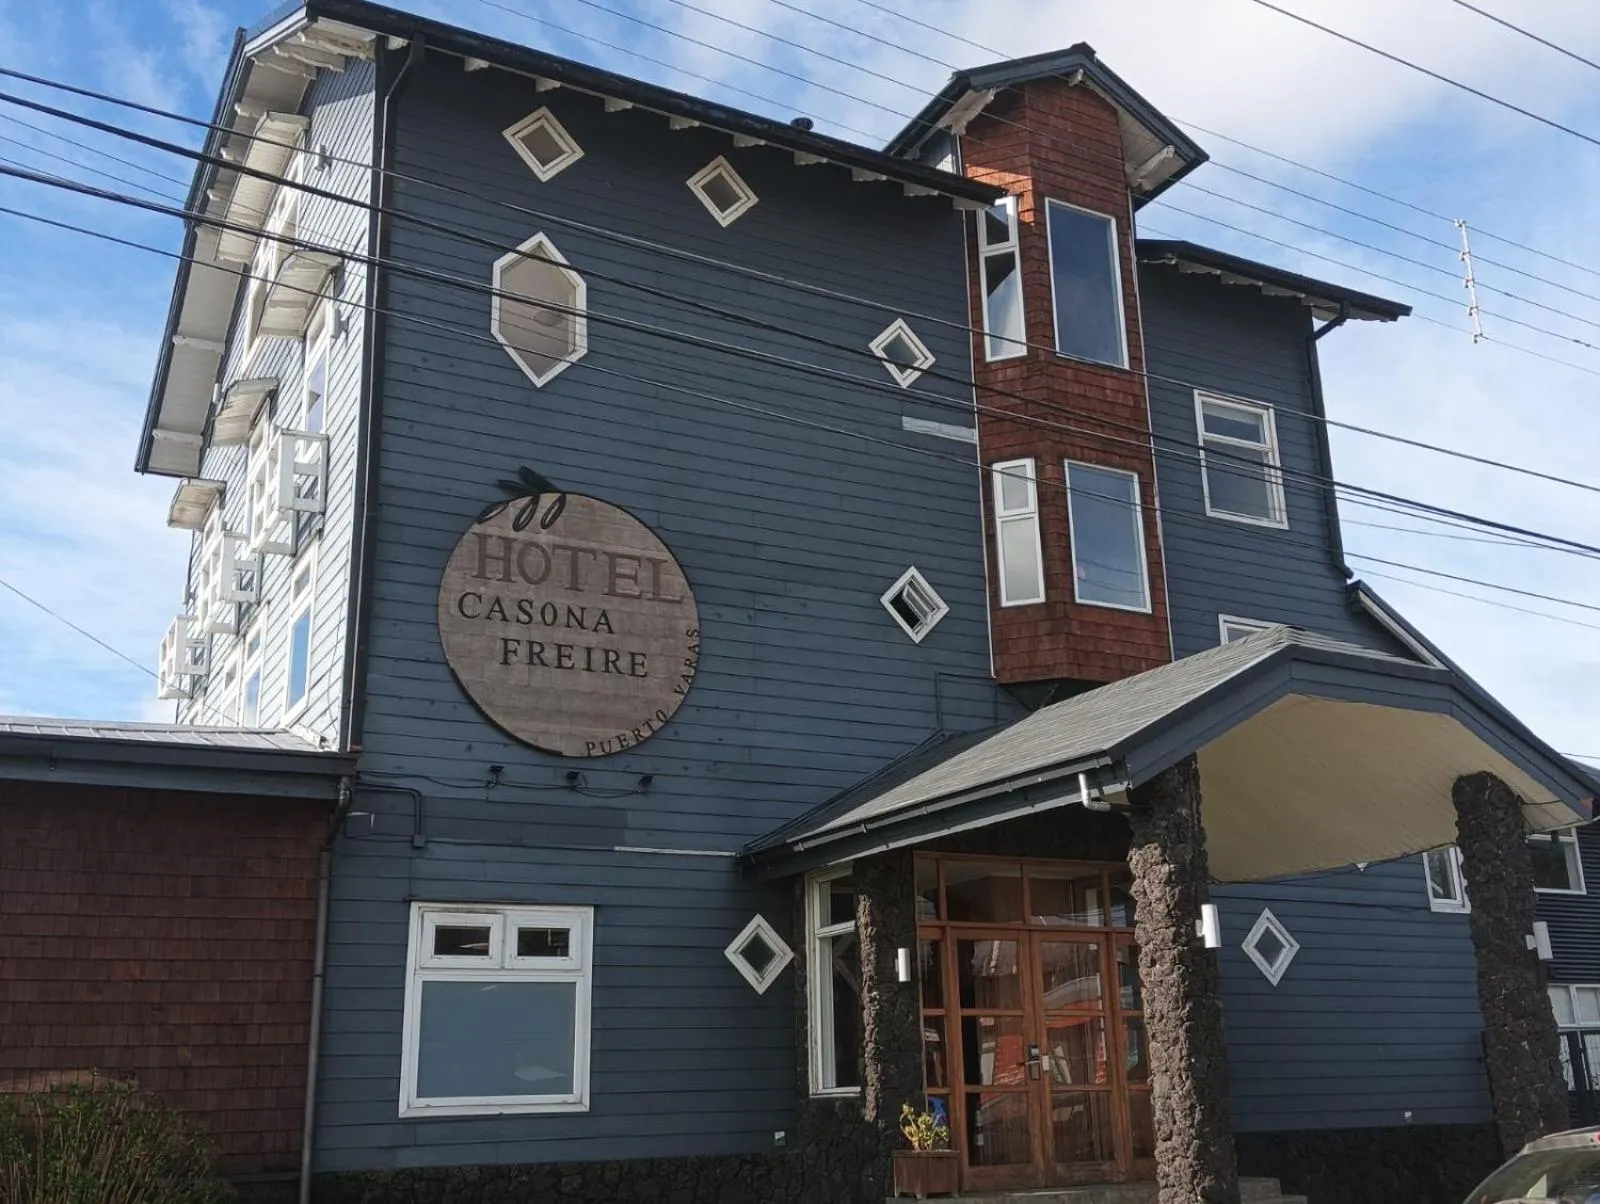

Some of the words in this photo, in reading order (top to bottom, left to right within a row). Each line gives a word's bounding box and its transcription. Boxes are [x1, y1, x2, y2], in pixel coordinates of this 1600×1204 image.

[470, 532, 684, 604] HOTEL
[457, 591, 615, 634] CASONA
[500, 637, 649, 678] FREIRE
[584, 709, 668, 757] PUERTO
[673, 628, 700, 697] VARAS
